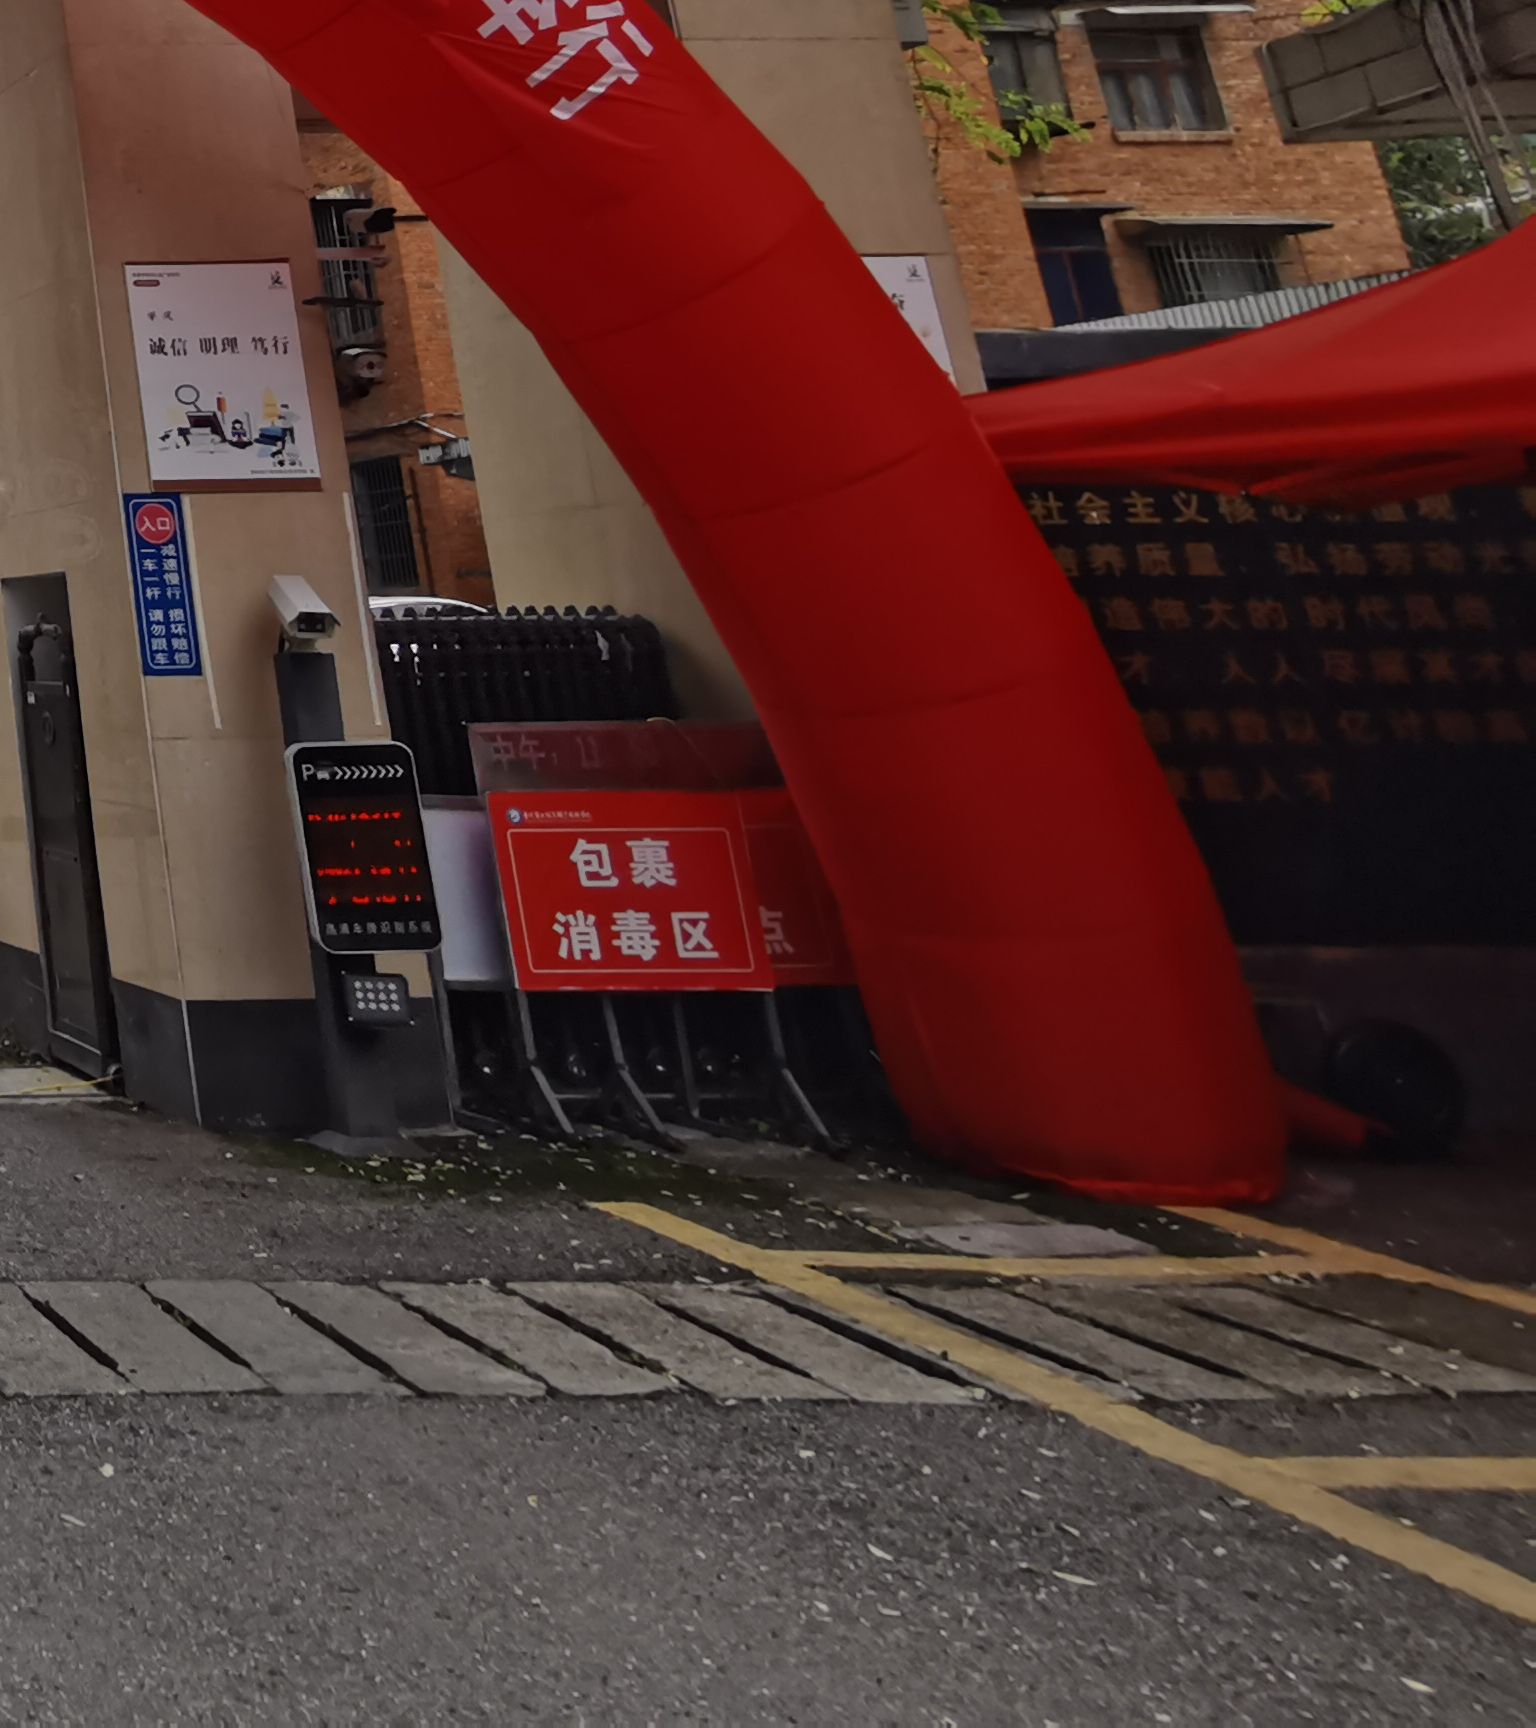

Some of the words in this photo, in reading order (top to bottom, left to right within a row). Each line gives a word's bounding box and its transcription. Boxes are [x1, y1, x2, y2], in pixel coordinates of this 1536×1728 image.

[141, 516, 171, 533] 入口
[140, 547, 162, 601] 一车一杆
[160, 543, 181, 600] 减速慢行
[147, 608, 170, 665] 请勿跟车
[570, 837, 677, 888] 包裹
[552, 909, 719, 962] 消毒区
